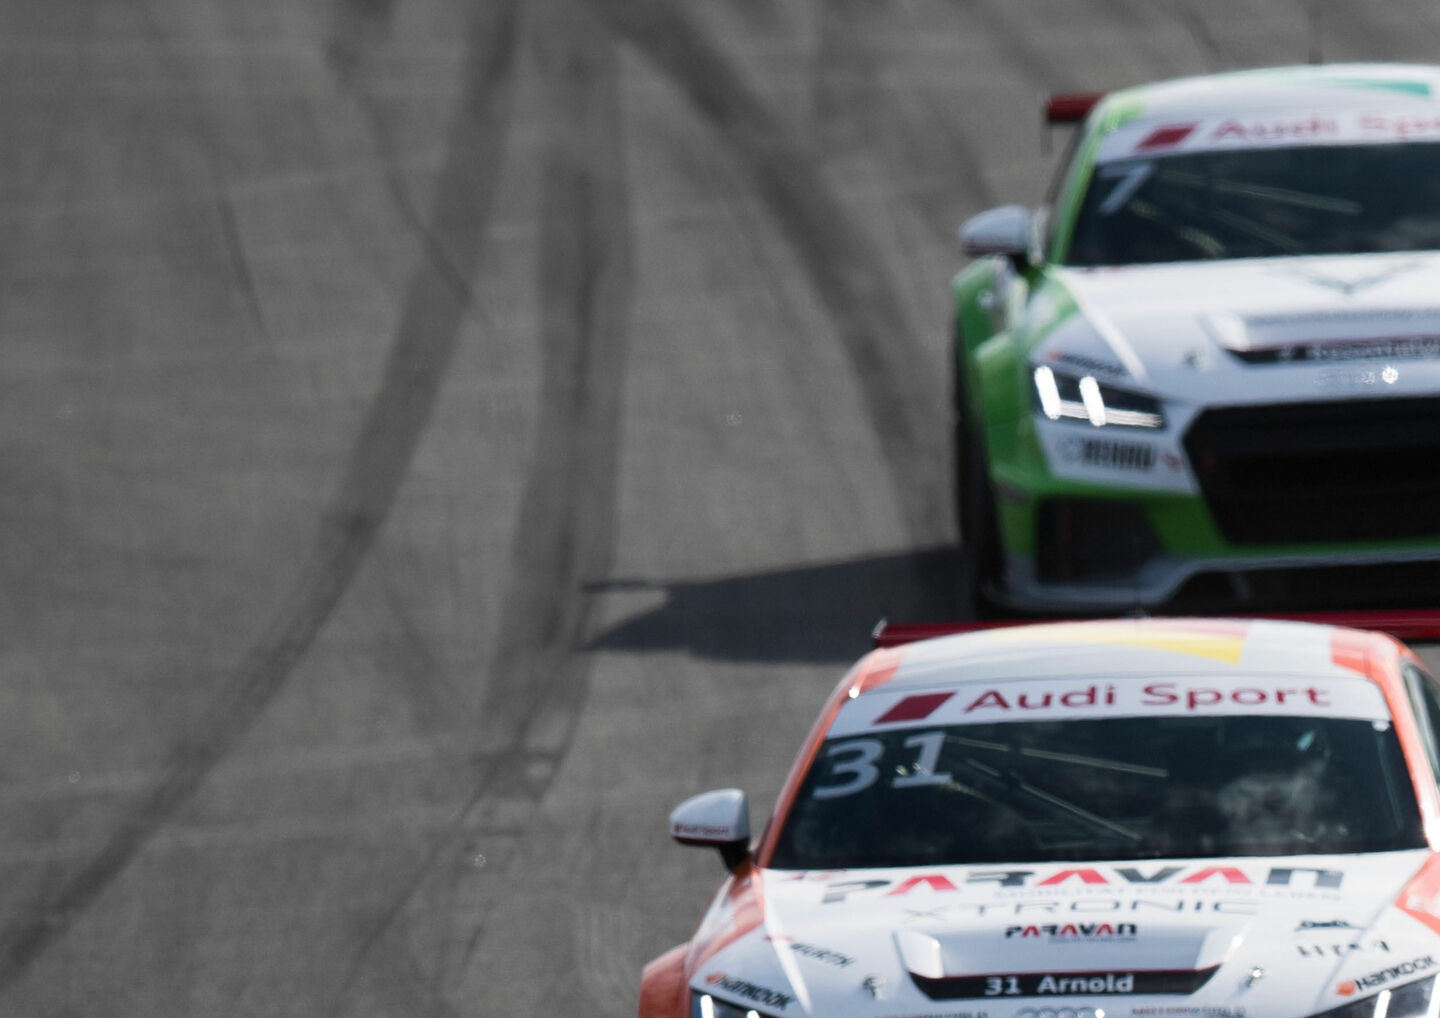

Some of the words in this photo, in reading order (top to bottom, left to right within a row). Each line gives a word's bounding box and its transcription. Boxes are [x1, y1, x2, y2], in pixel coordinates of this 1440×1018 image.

[1214, 118, 1337, 140] Audi
[1098, 162, 1152, 214] 7
[965, 685, 1115, 713] Audi
[1141, 683, 1332, 710] Sport
[812, 731, 954, 799] 31
[983, 977, 1022, 996] 31
[1037, 974, 1135, 994] Arnold
